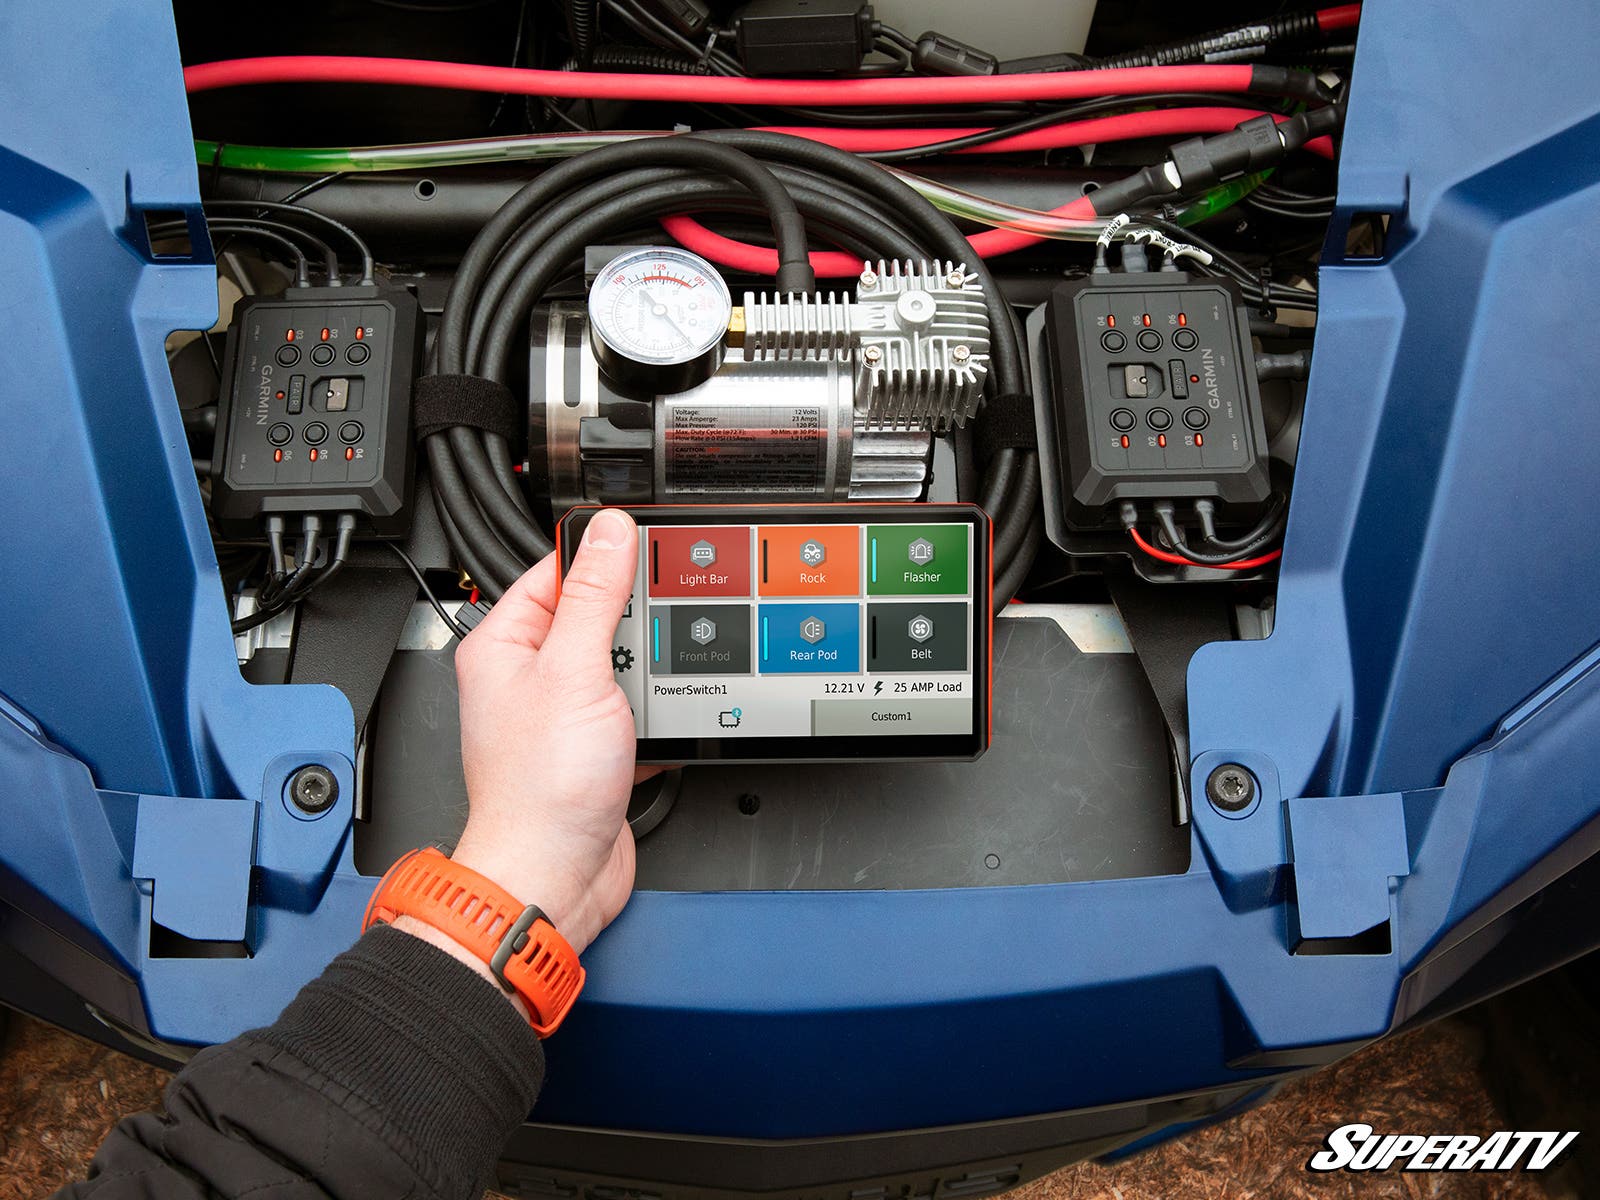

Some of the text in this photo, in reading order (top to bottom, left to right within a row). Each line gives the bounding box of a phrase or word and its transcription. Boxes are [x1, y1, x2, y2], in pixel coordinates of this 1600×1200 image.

[653, 263, 666, 271] 125
[613, 274, 626, 286] 100
[694, 275, 708, 287] 150
[1097, 316, 1105, 326] 04
[1133, 315, 1141, 325] 05
[1169, 314, 1177, 325] 06
[296, 330, 304, 340] 03
[330, 329, 338, 339] 02
[366, 328, 374, 337] 01
[1173, 367, 1184, 391] PAIR
[1201, 348, 1220, 409] GARMIN
[257, 364, 272, 425] GARMIN
[292, 382, 301, 407] PAIR
[1112, 437, 1120, 448] 01
[1148, 436, 1157, 447] 02
[1185, 435, 1193, 446] 03
[284, 450, 292, 461] 06
[320, 450, 328, 460] 05
[356, 448, 364, 459] 04
[679, 574, 728, 587] Light Bar
[800, 573, 826, 584] Rock
[903, 571, 941, 583] Flasher
[679, 651, 731, 662] Front Pod
[790, 650, 837, 661] Rear Pod
[911, 649, 932, 660] Belt
[654, 684, 728, 696] PowerSwitch1
[824, 683, 865, 694] 12.21 V
[893, 681, 962, 693] 25 AMP Load
[871, 711, 912, 722] Custom1
